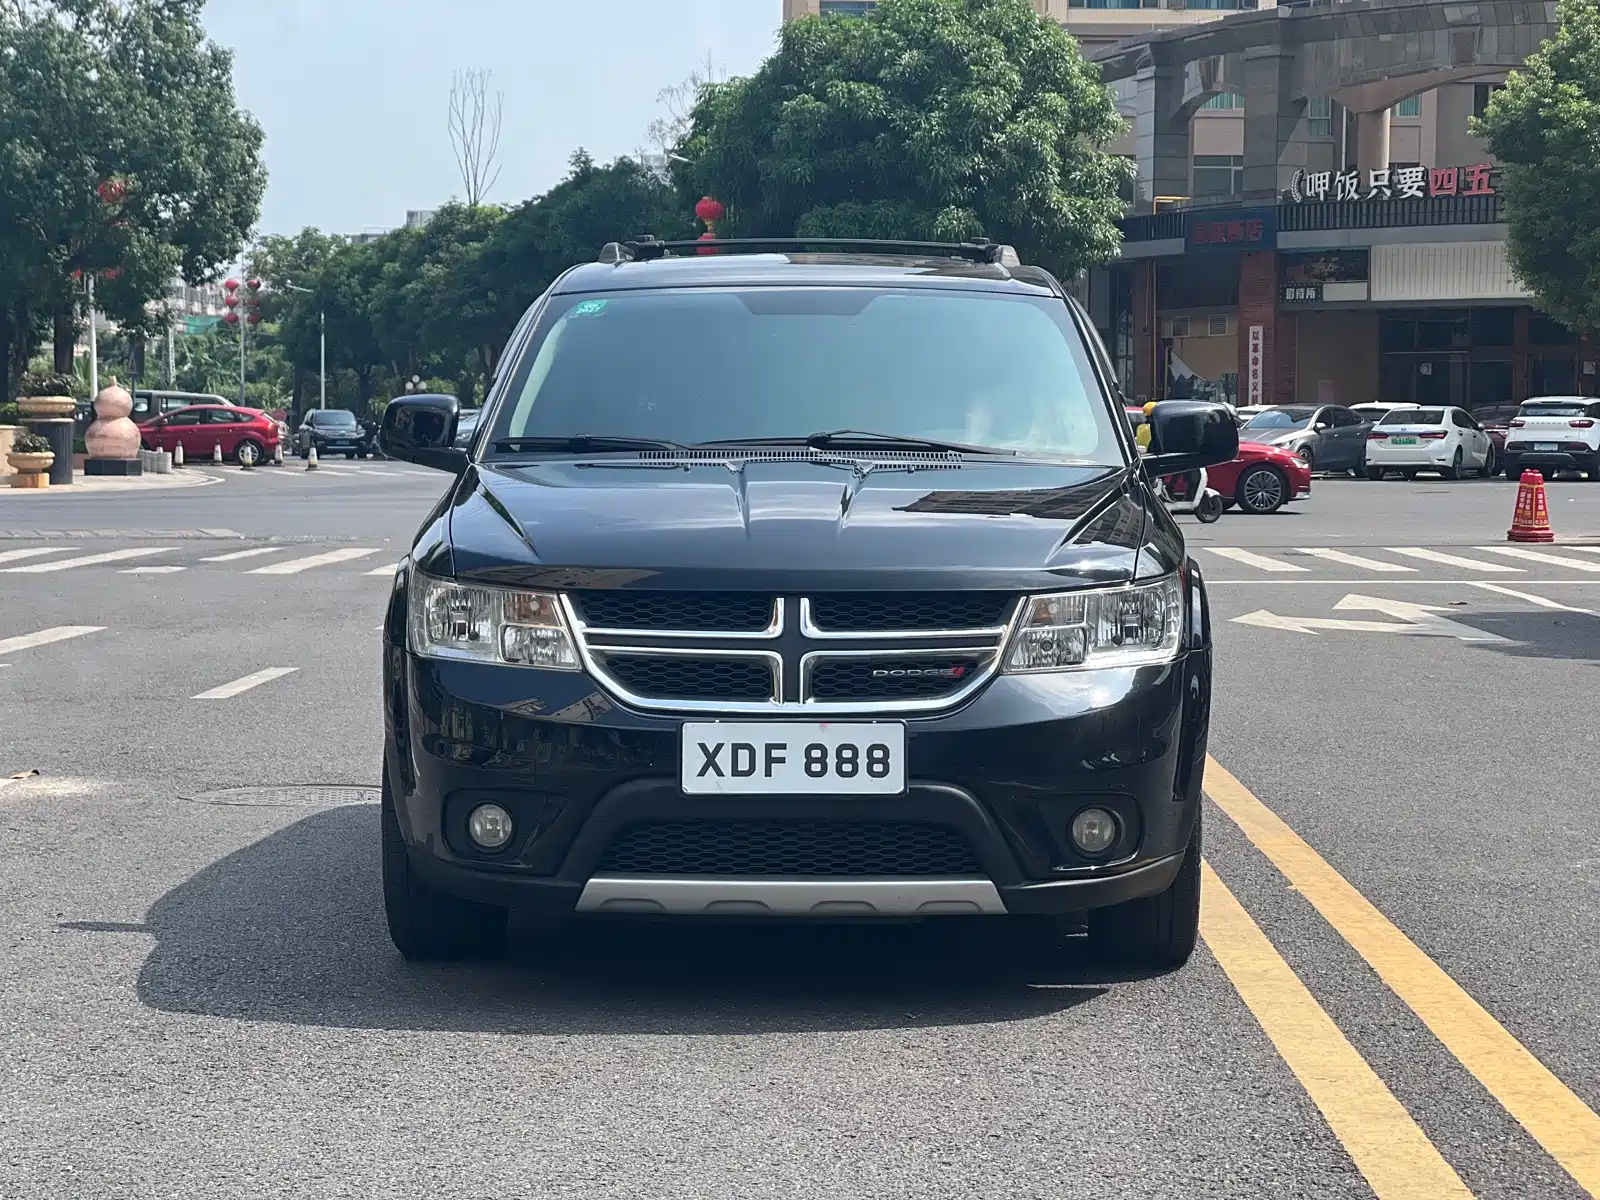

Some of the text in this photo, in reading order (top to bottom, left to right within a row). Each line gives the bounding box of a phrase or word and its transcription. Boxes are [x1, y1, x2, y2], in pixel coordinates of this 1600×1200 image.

[1305, 162, 1496, 201] 呷饭只要四五
[872, 668, 954, 677] DODGE
[696, 742, 891, 779] XDF 888
